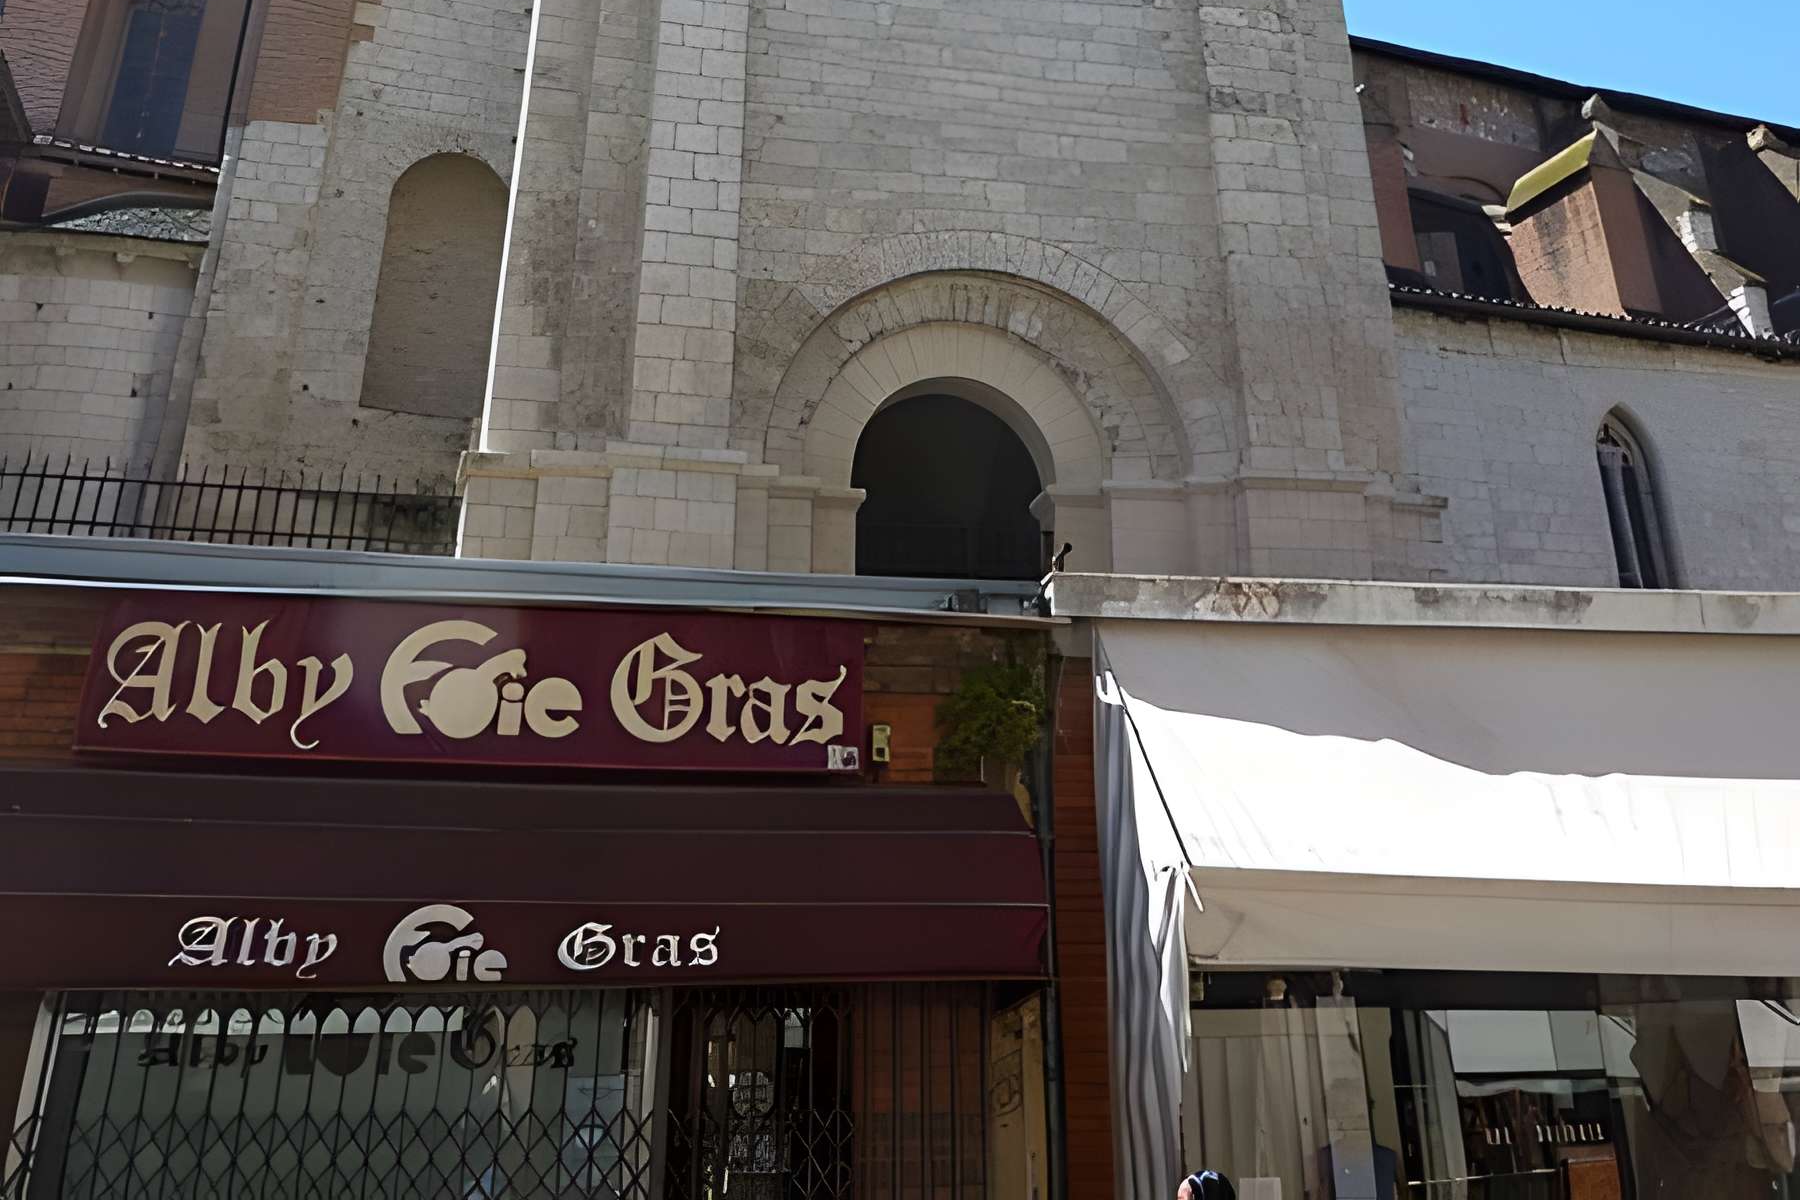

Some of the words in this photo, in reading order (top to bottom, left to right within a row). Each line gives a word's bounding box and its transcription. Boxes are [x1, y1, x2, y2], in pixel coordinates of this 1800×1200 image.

[97, 619, 354, 750] Alby
[380, 619, 583, 739] Foie
[610, 631, 847, 746] Gras
[167, 915, 338, 979] Alby
[382, 903, 508, 983] Foie
[556, 921, 720, 971] Gras
